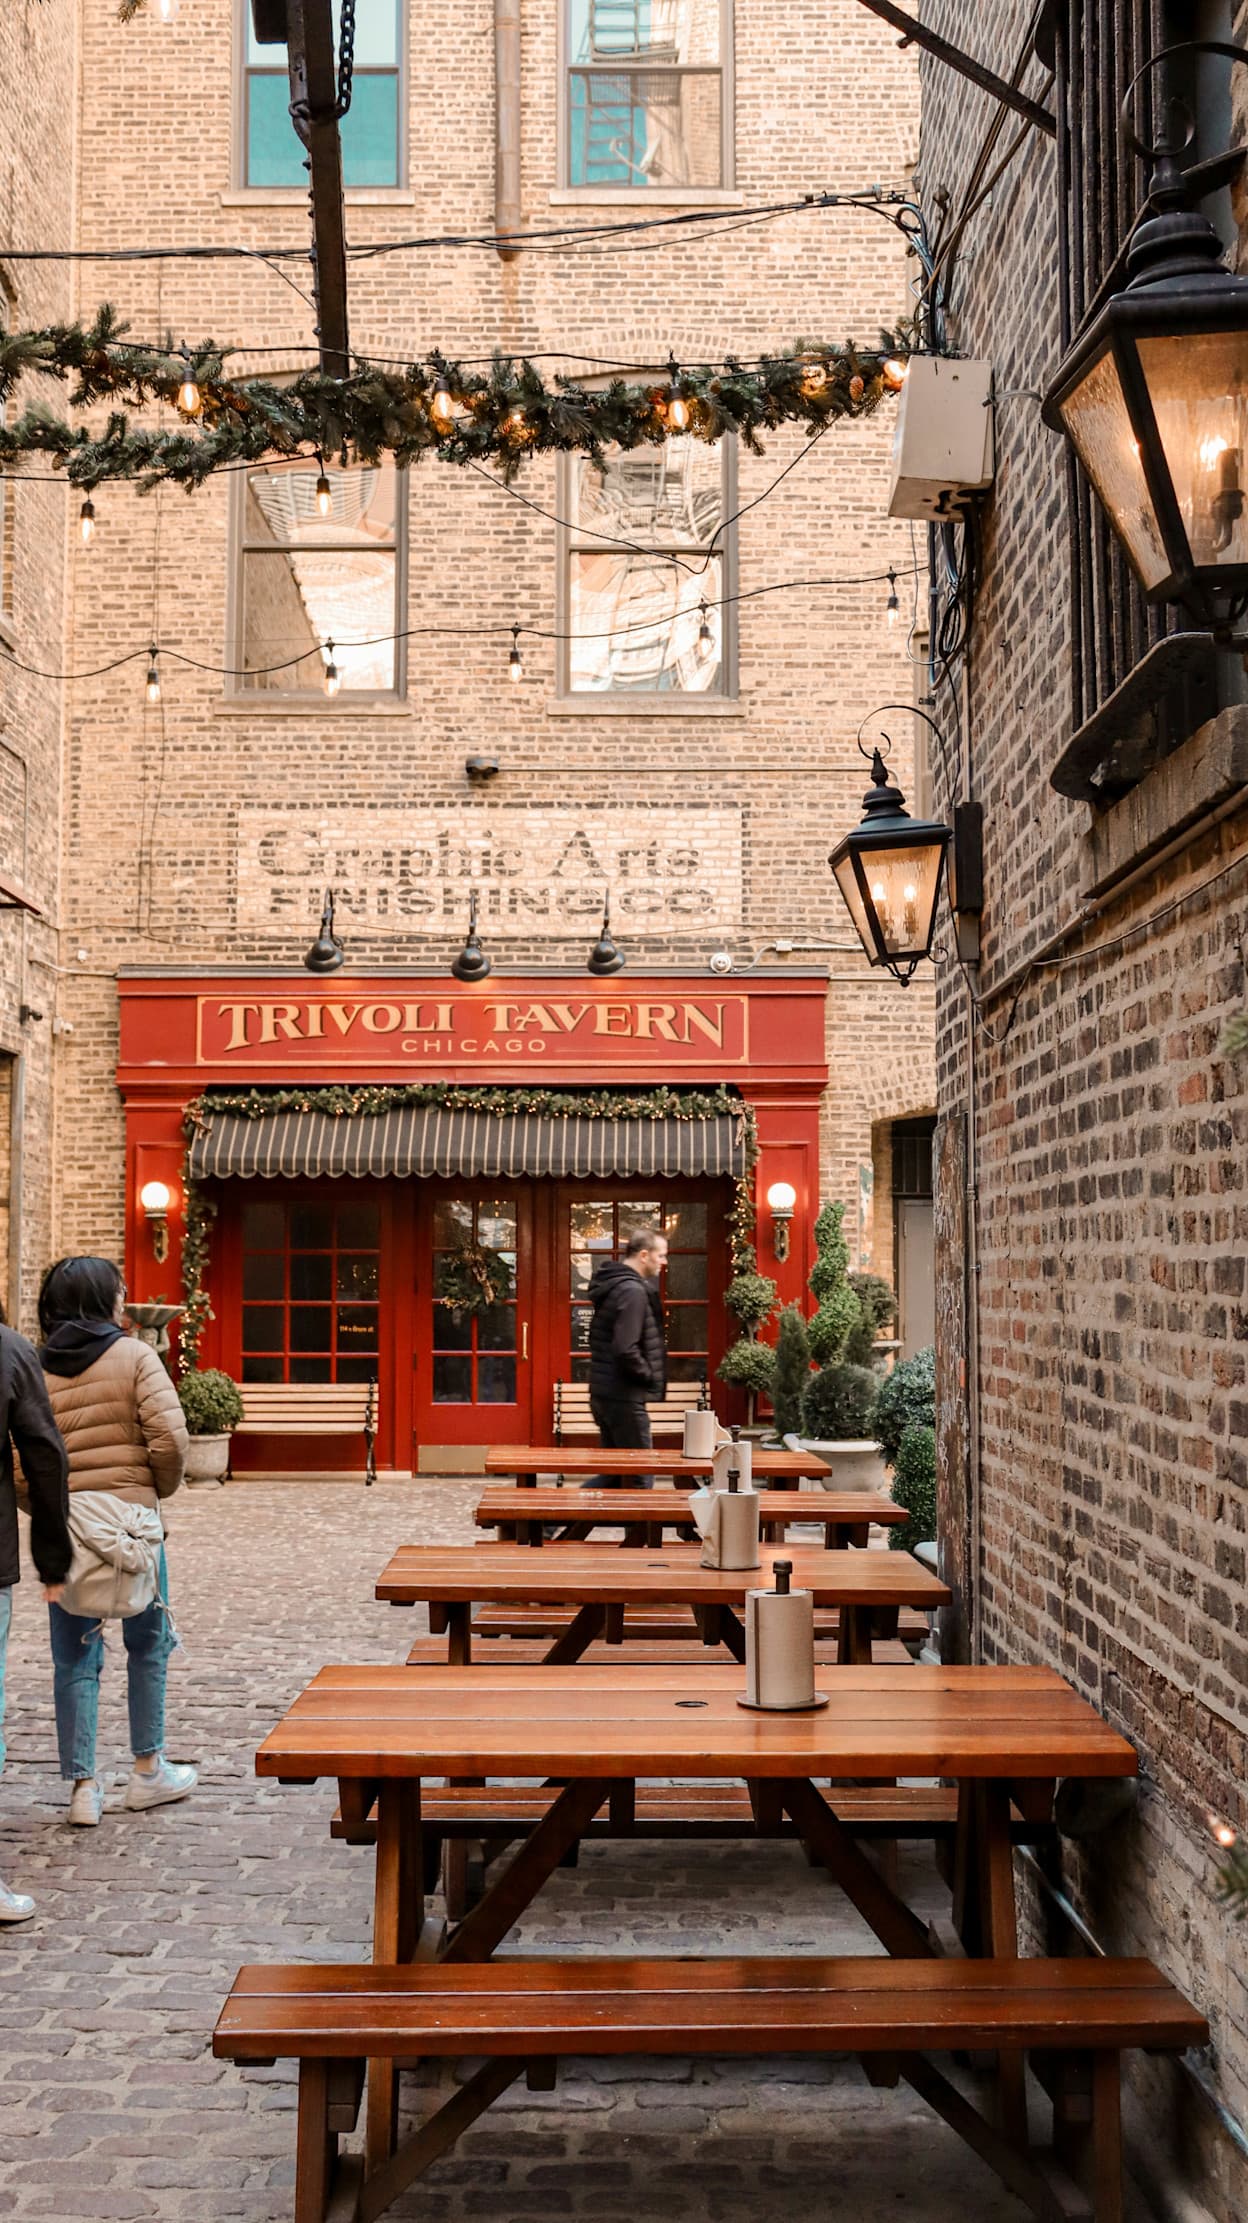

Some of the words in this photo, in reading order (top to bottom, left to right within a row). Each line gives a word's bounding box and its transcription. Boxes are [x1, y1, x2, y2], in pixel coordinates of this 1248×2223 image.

[257, 829, 524, 885] Graphic
[547, 829, 699, 878] Arts
[218, 1003, 456, 1053] TRIVOLI
[483, 1003, 727, 1050] TAVERN
[401, 1039, 546, 1053] CHICAGO
